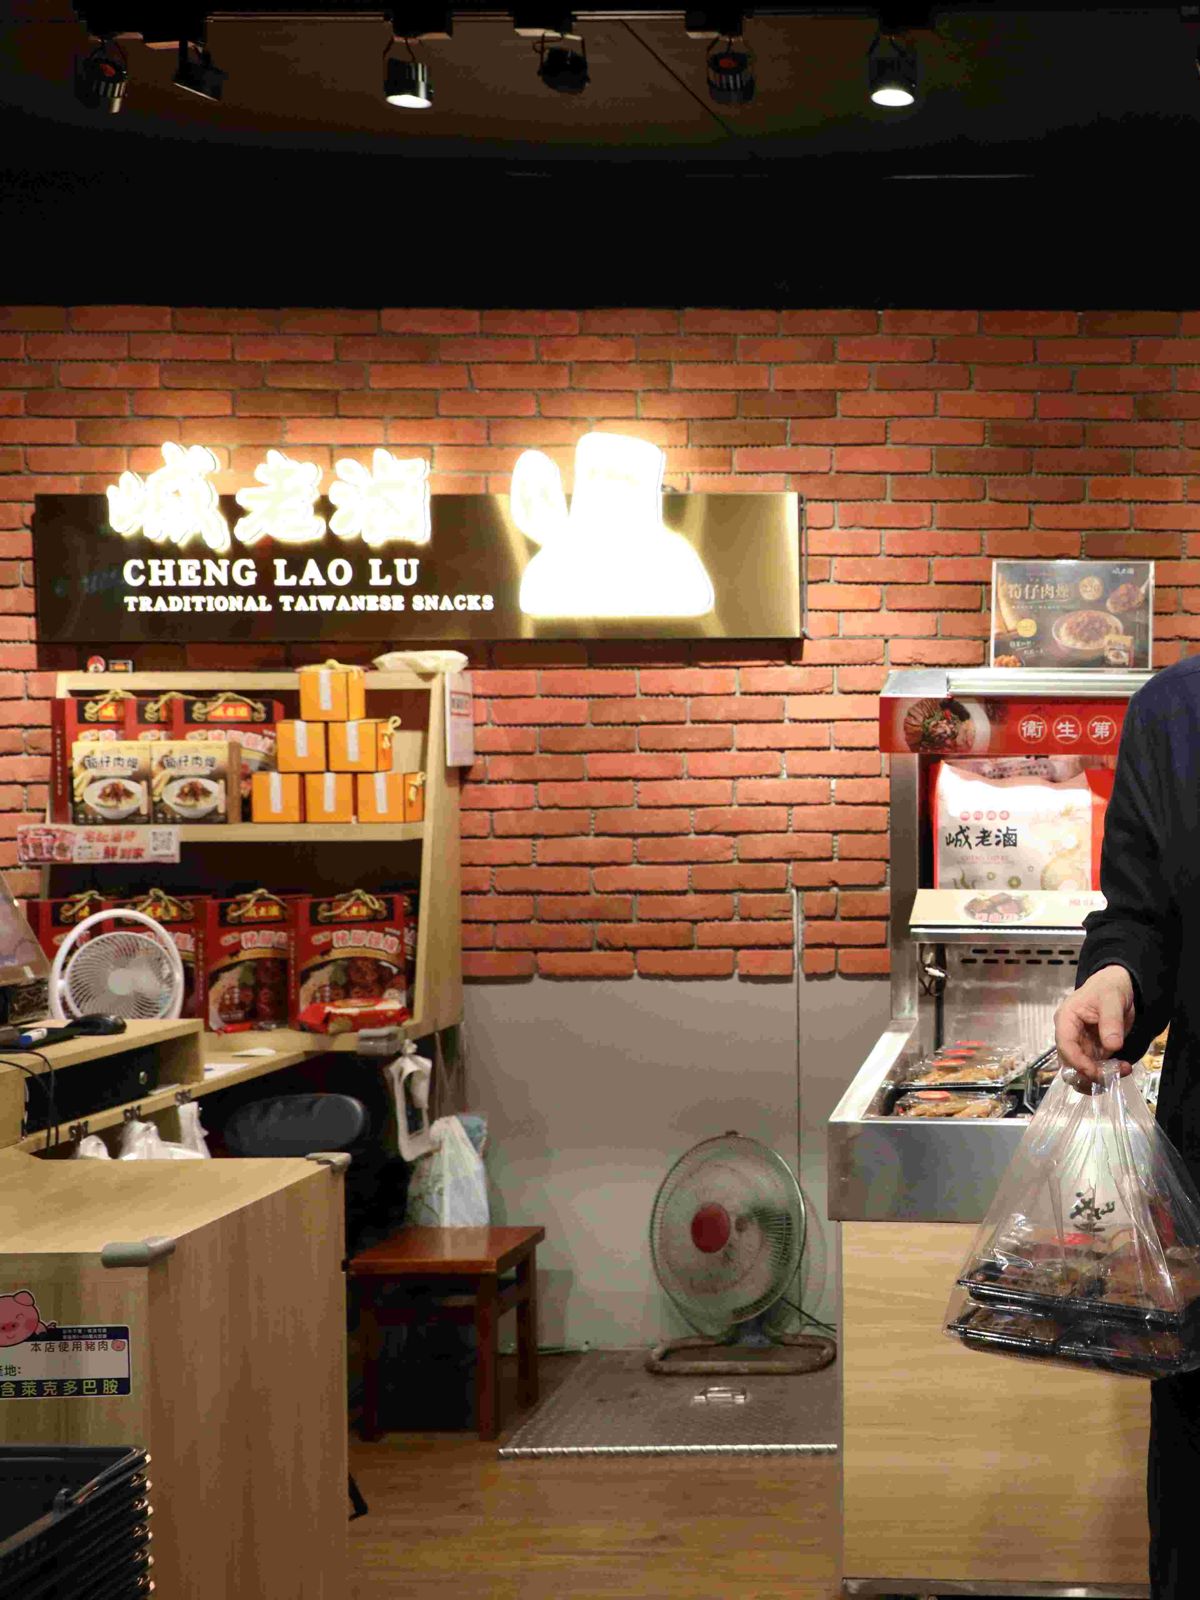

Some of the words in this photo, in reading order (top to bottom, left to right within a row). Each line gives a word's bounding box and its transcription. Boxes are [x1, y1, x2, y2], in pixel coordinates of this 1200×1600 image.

[123, 558, 258, 587] CHENG
[273, 559, 353, 587] LAO
[368, 558, 420, 587] LU
[123, 596, 272, 612] TRADITIONAL
[279, 596, 405, 612] TAIWANESE
[412, 595, 494, 612] SNACKS
[1021, 720, 1113, 740] 衛生第
[30, 1340, 109, 1353] 本店使用豬肉
[1, 1378, 119, 1398] 含萊克多巴胺
